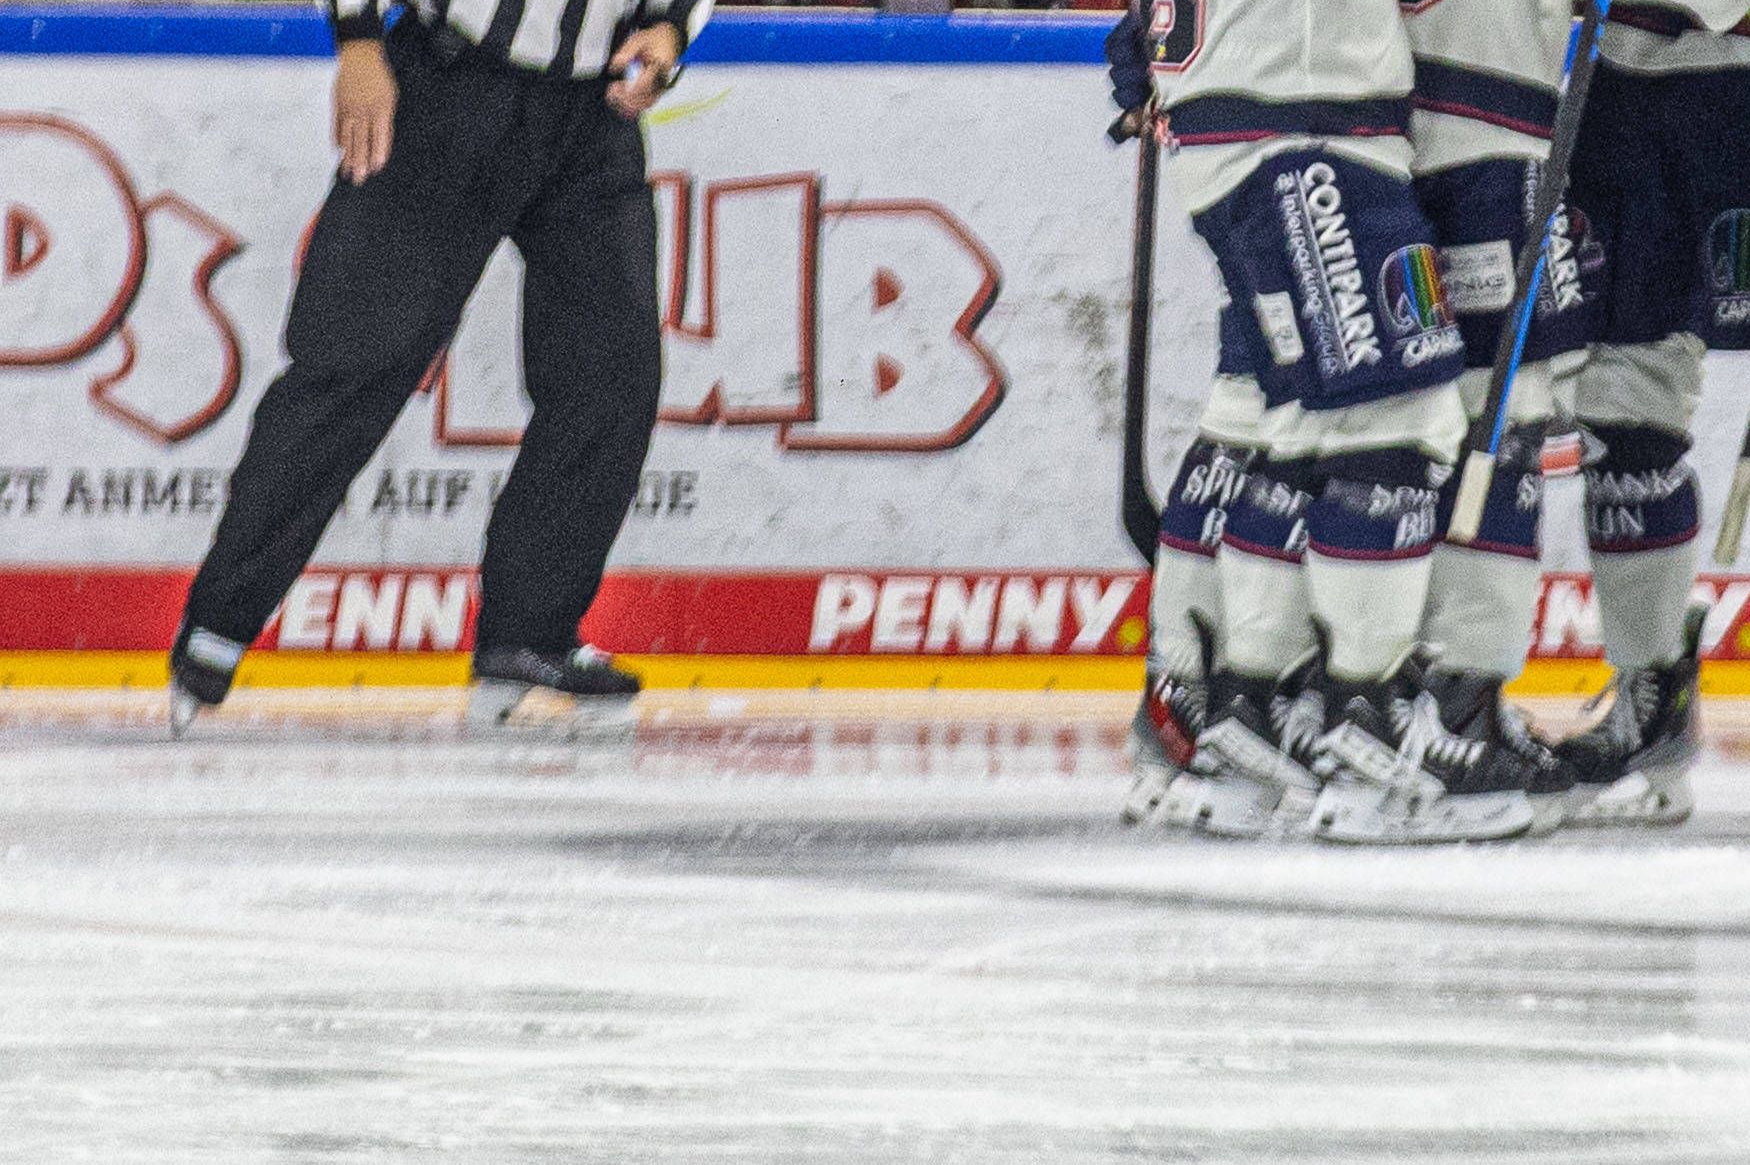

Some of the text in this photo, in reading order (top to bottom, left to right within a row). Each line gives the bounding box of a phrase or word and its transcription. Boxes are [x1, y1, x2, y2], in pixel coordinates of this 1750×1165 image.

[1303, 162, 1384, 372] CONTIPARK
[371, 469, 470, 517] AUF
[262, 574, 480, 652] ENN
